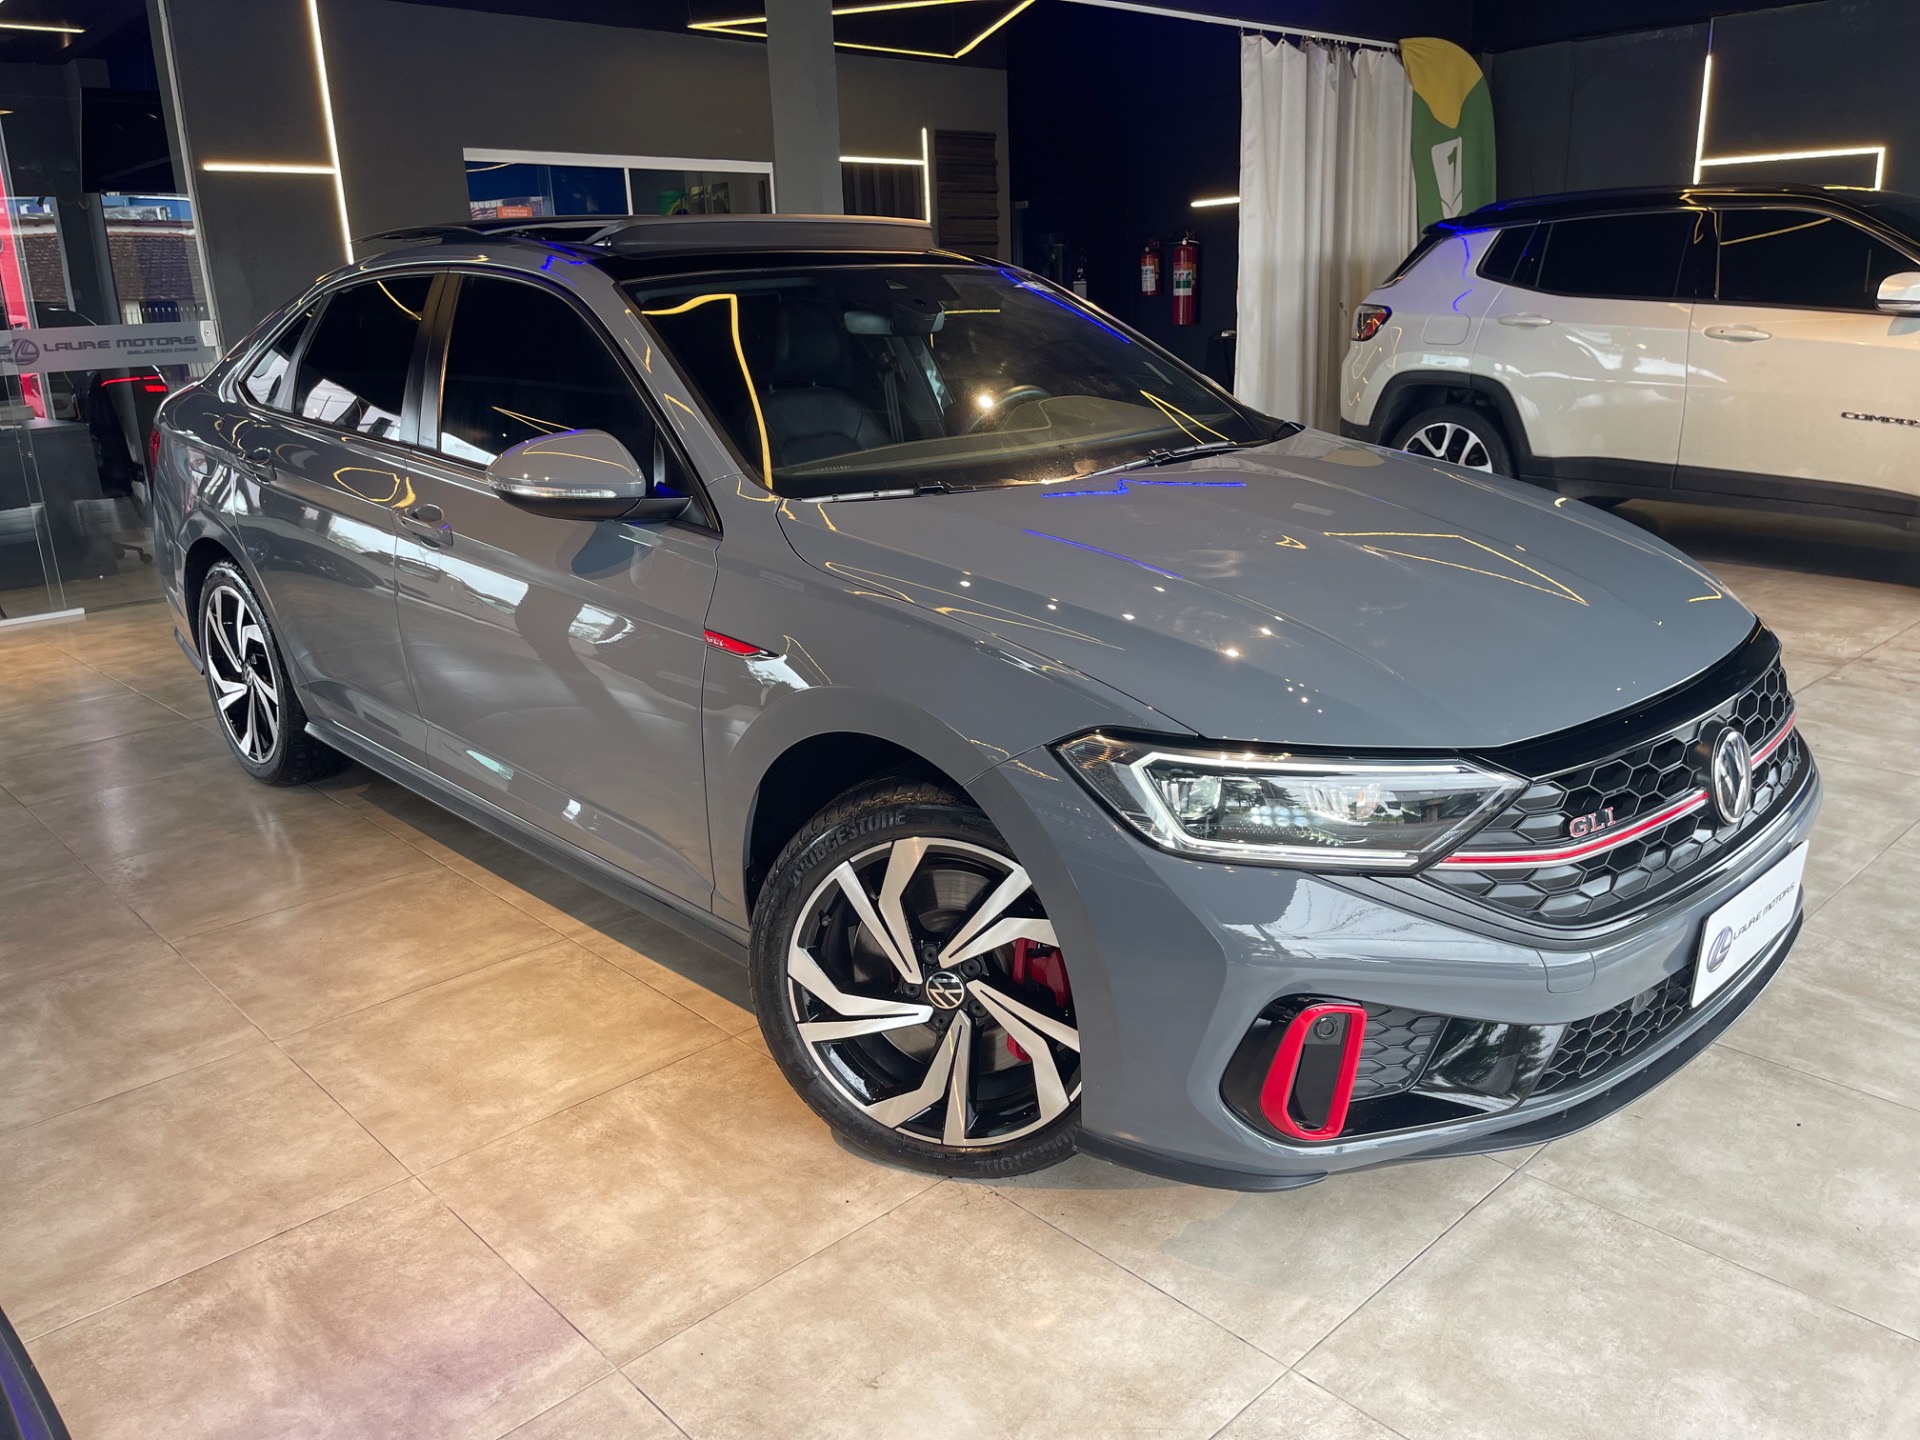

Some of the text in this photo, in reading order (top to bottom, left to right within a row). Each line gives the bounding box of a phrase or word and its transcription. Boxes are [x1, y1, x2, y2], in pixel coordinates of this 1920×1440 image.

[43, 335, 197, 352] LAURE MOTORS
[706, 636, 723, 647] GLI
[1570, 806, 1616, 838] GLI
[1733, 881, 1796, 941] LAURE MOTORS
